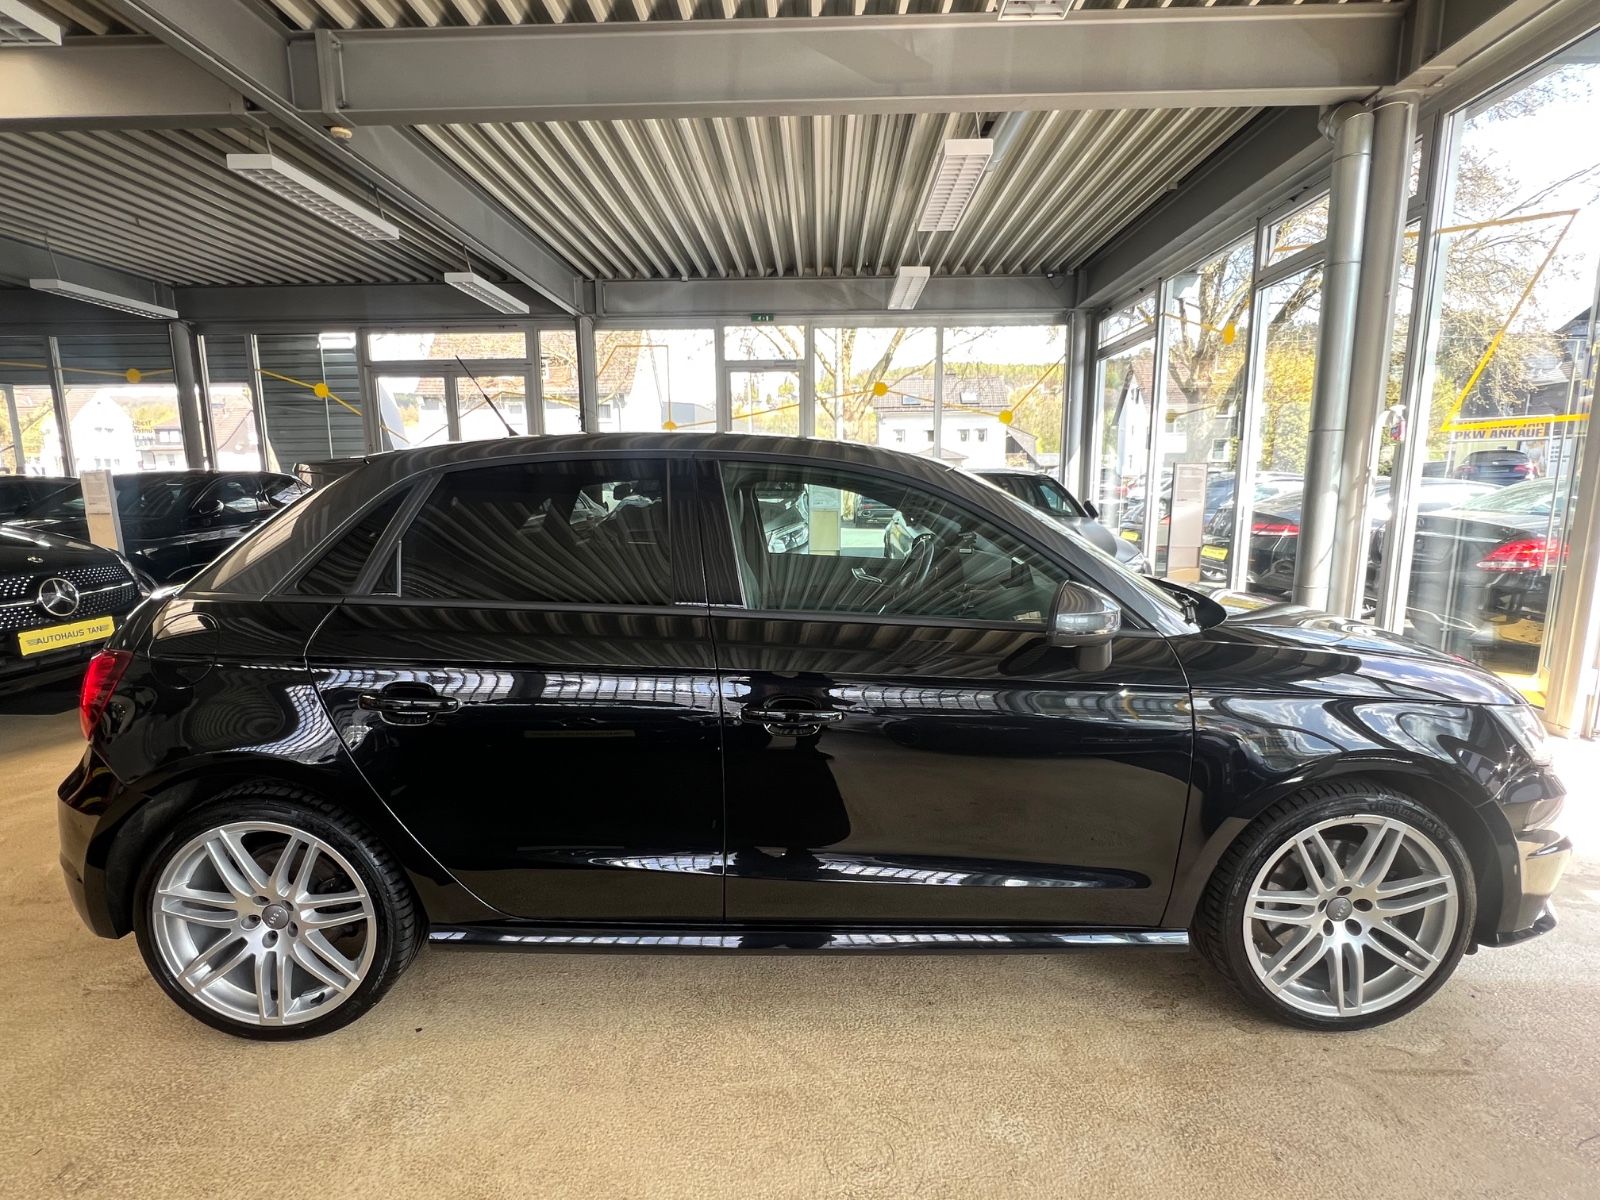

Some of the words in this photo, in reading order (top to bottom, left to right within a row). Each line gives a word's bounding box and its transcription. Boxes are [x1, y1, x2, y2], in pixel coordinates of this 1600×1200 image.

[1454, 430, 1486, 439] PKW
[1490, 428, 1543, 439] ANKAUF
[36, 629, 85, 645] AUTOHAUS
[87, 625, 102, 635] TAN
